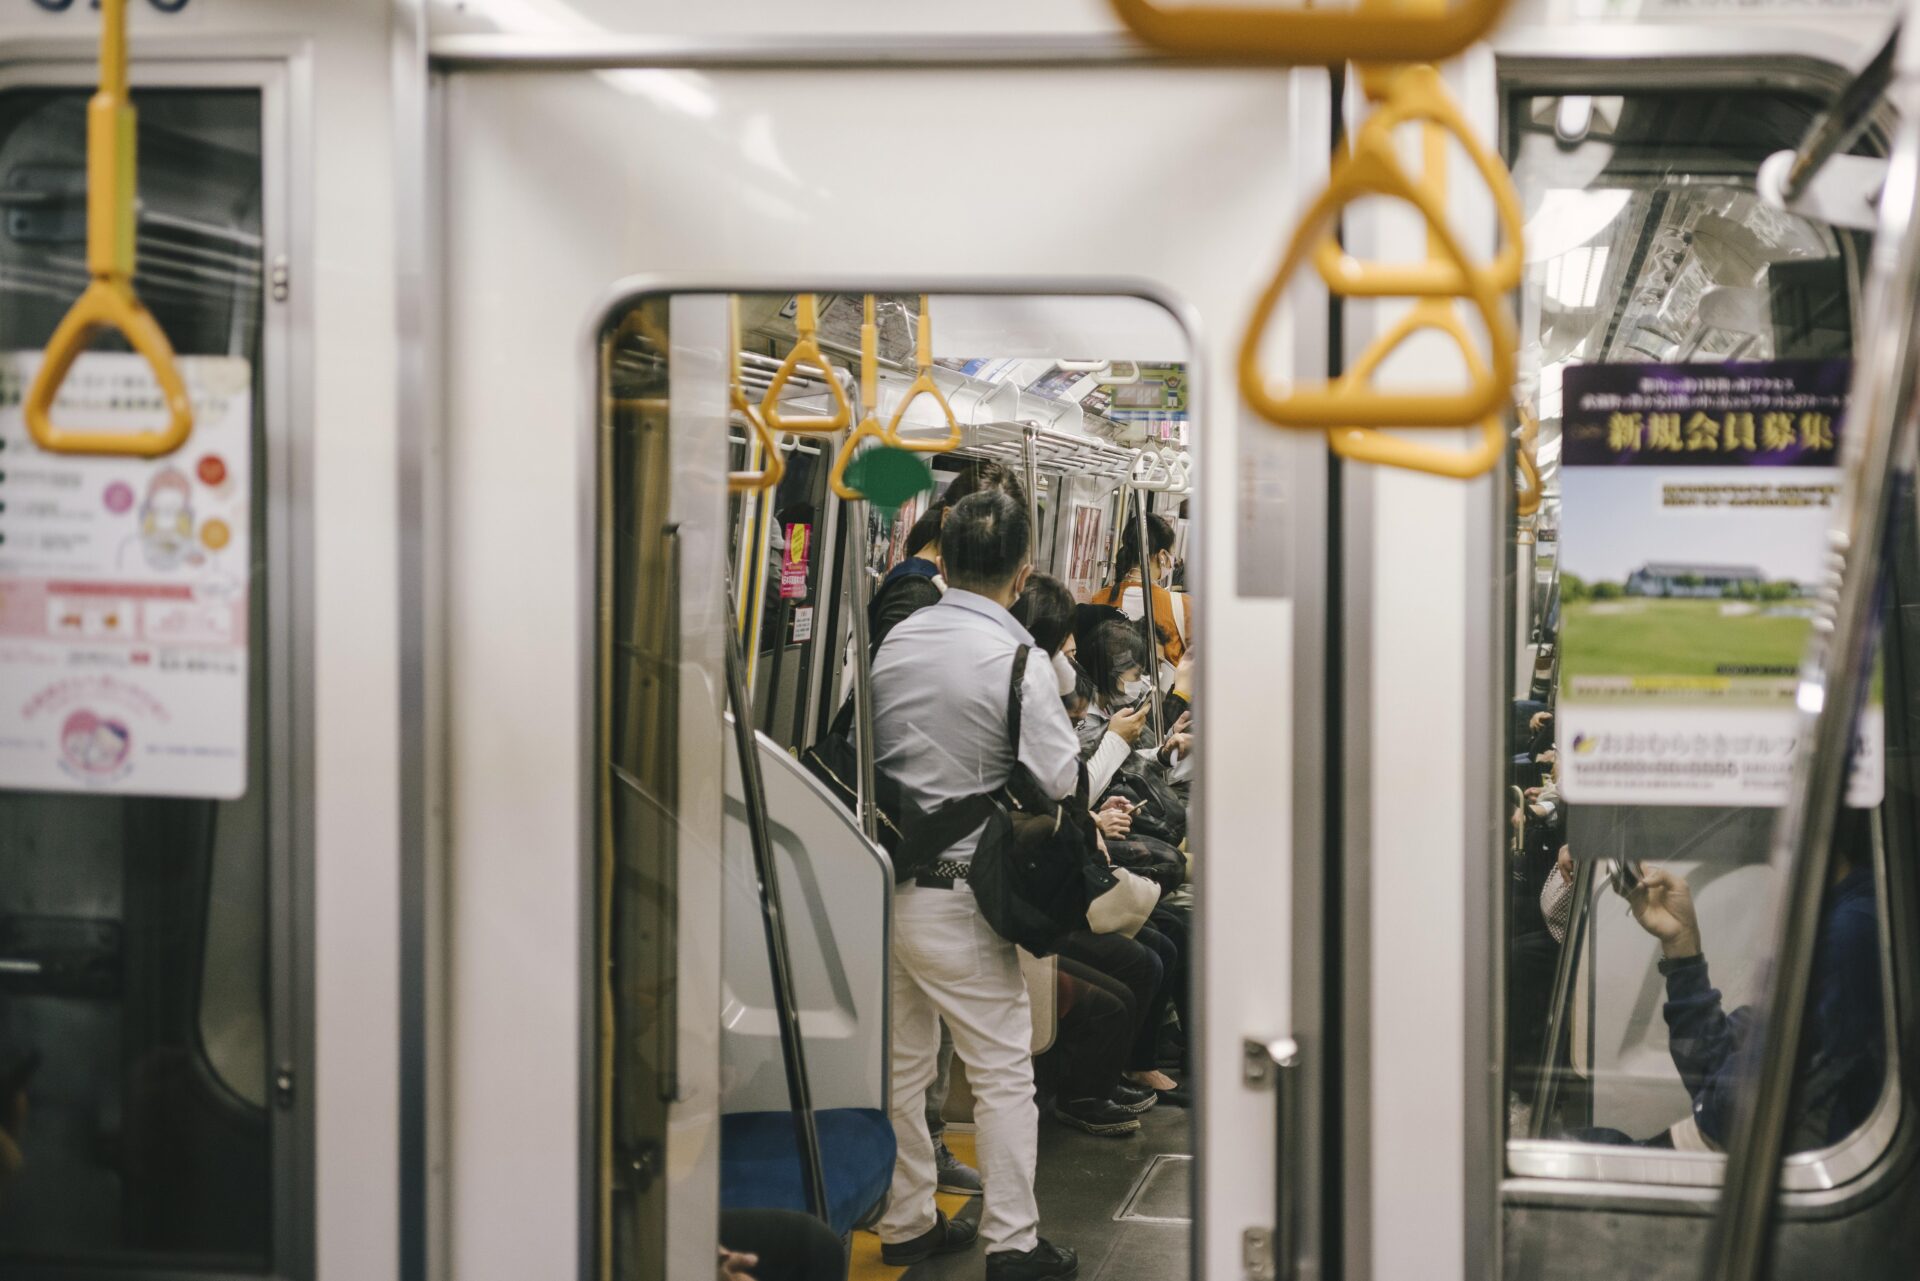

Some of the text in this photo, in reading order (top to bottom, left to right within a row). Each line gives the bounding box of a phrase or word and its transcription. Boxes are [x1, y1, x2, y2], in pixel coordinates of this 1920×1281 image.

[1608, 410, 1834, 451] 新規会員募集
